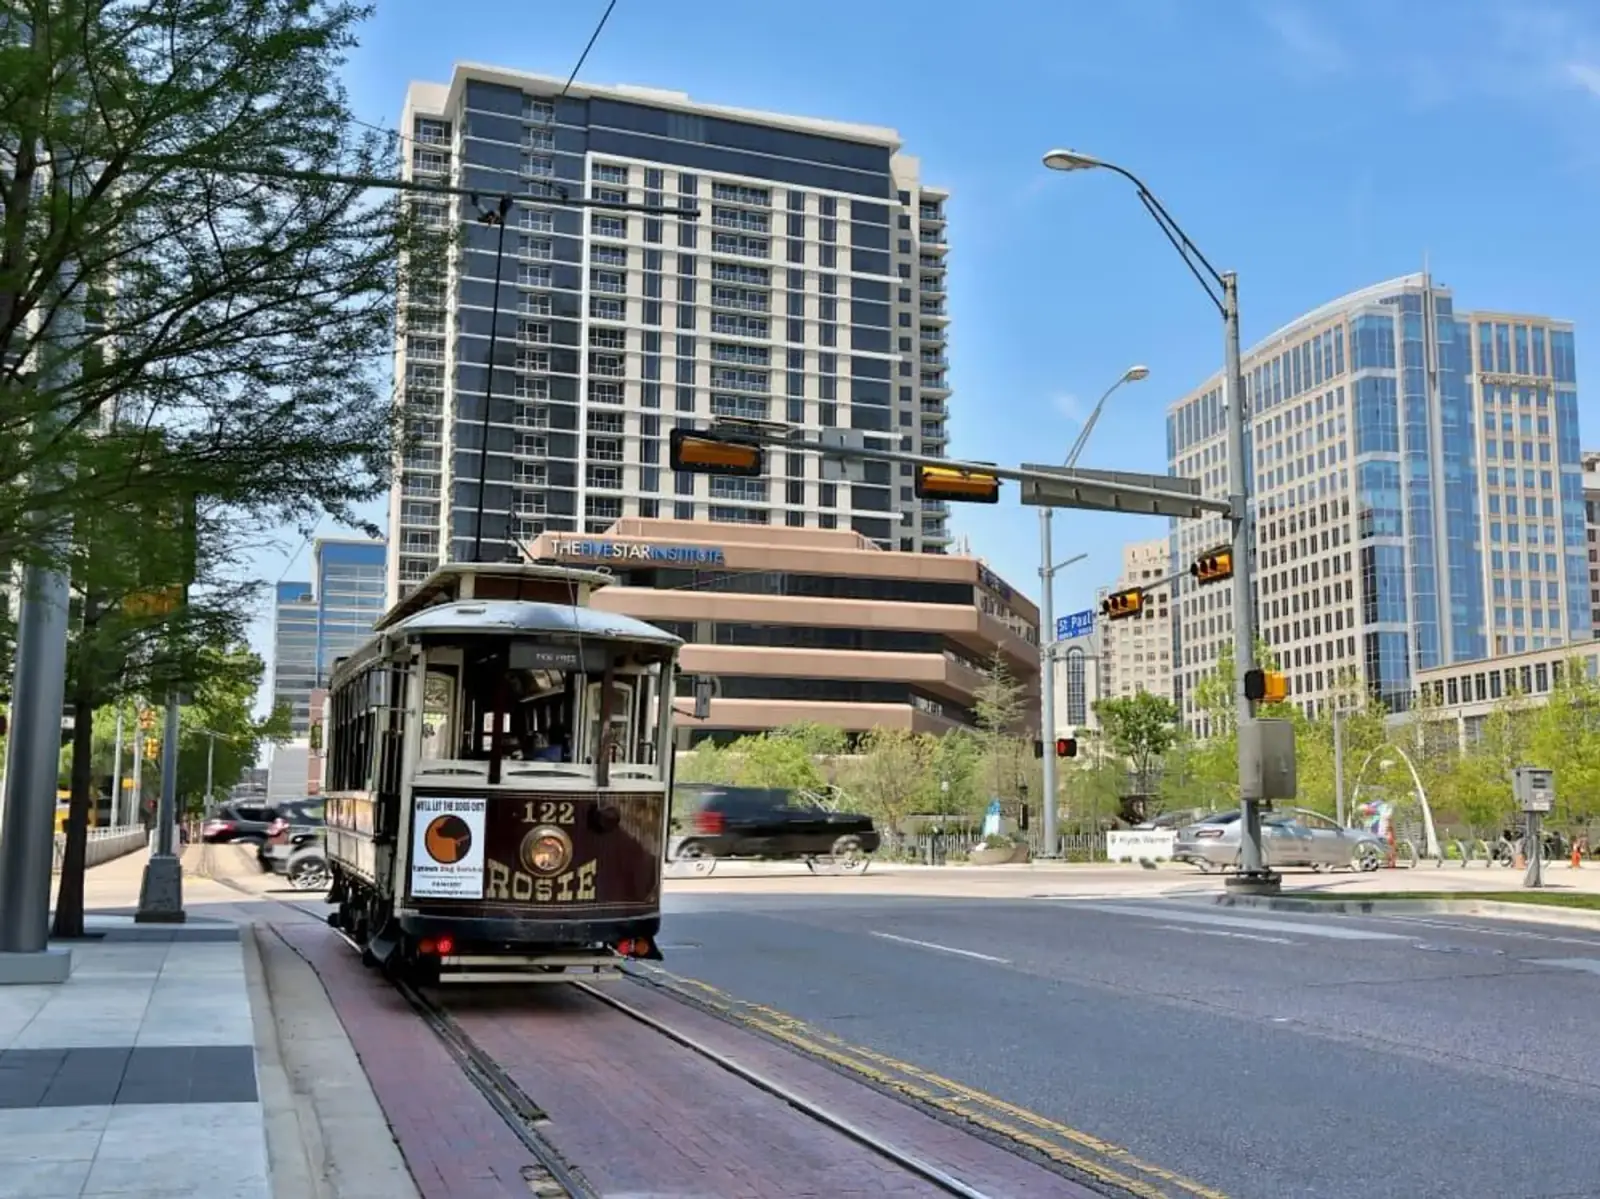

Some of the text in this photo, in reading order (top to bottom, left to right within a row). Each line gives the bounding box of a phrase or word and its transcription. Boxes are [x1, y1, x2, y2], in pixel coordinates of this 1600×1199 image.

[1071, 611, 1091, 628] Paul
[520, 801, 576, 824] 122
[486, 857, 598, 901] ROSIE
